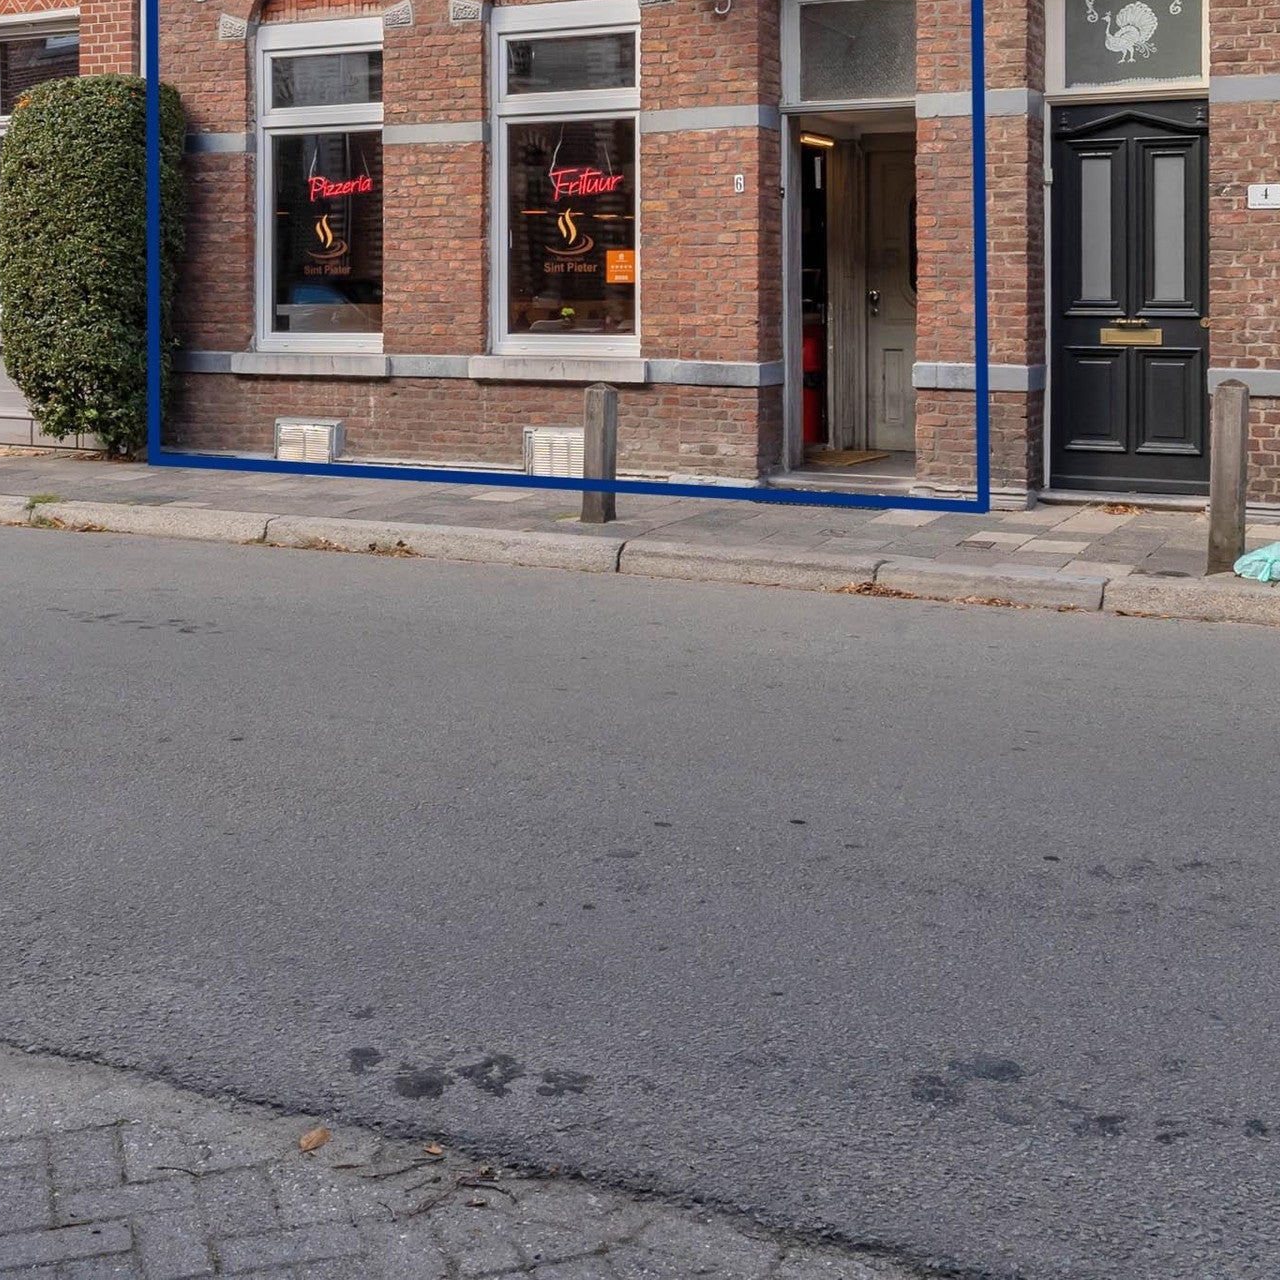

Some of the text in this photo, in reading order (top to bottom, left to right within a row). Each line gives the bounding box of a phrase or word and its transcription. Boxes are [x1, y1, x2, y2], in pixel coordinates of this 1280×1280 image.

[308, 175, 372, 202] Pizzeria
[549, 167, 624, 201] Frituur
[735, 176, 743, 191] 6
[303, 265, 323, 276] Sint
[544, 262, 598, 273] Sint Pieter
